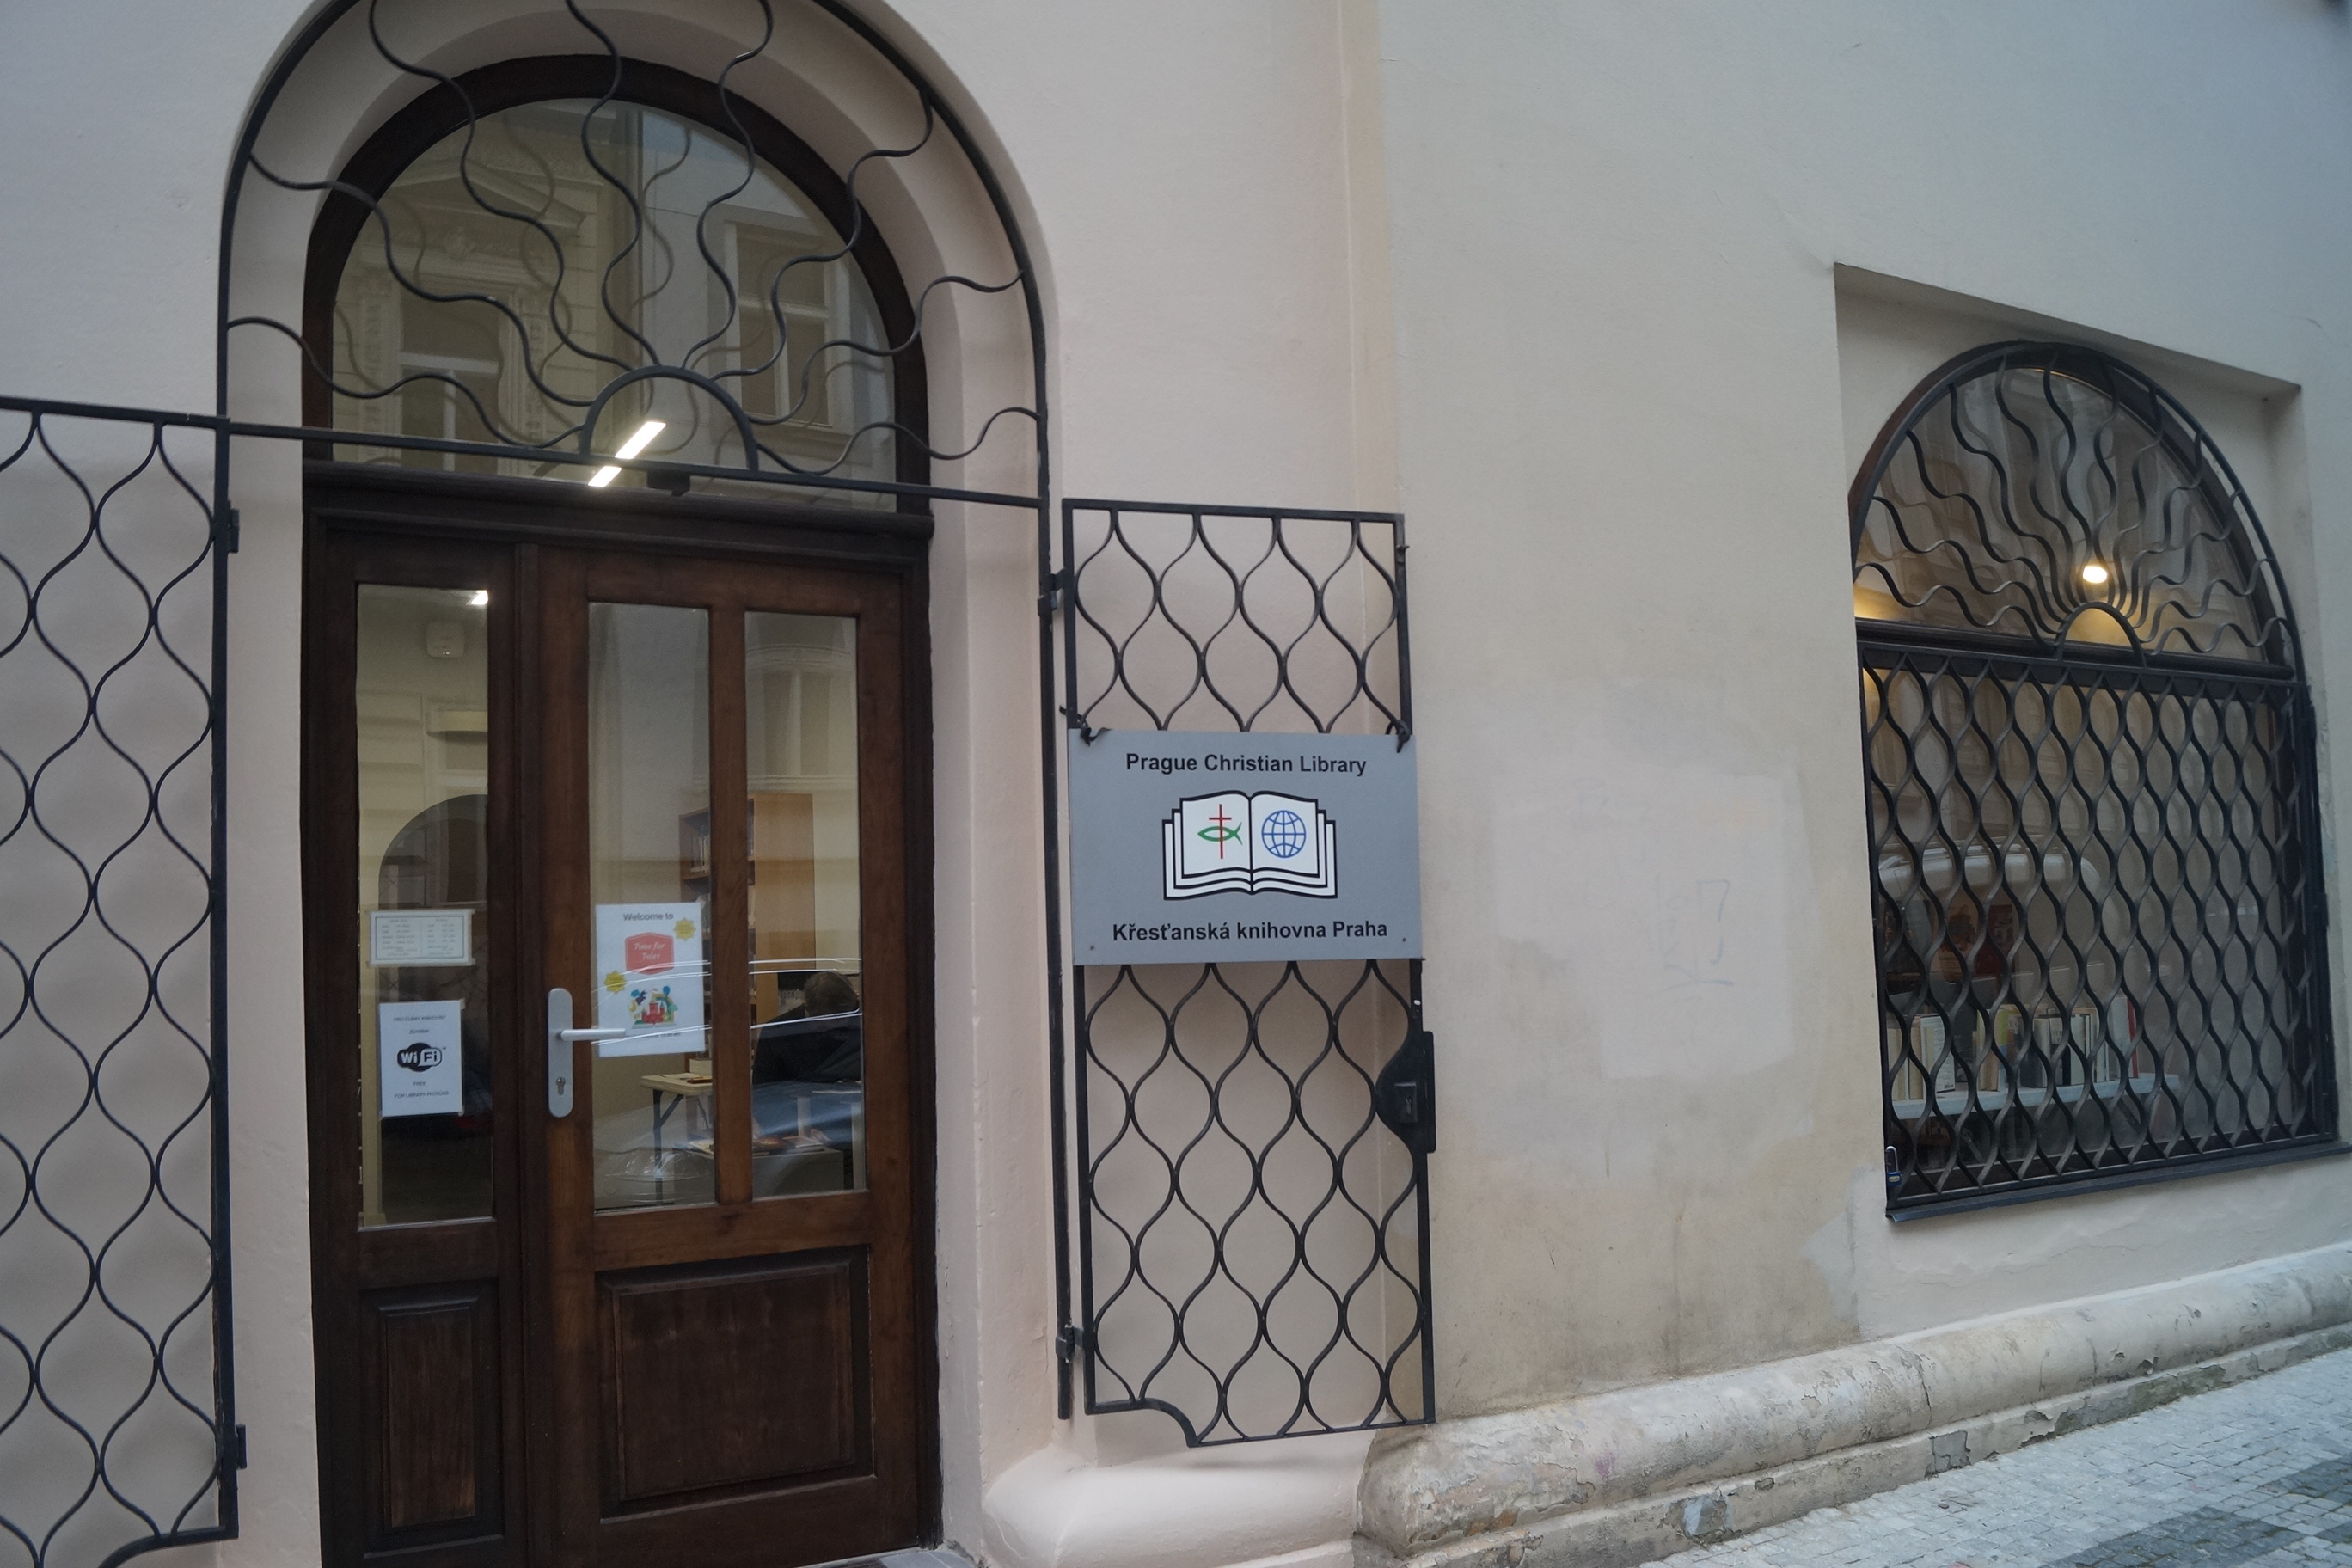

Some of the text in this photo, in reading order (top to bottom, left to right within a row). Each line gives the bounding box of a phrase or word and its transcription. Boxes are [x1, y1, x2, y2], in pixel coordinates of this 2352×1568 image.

[1126, 753, 1367, 776] Prague Christian Library
[623, 912, 664, 921] Welcome
[1112, 921, 1387, 941] Křesťanská knihovna Praha
